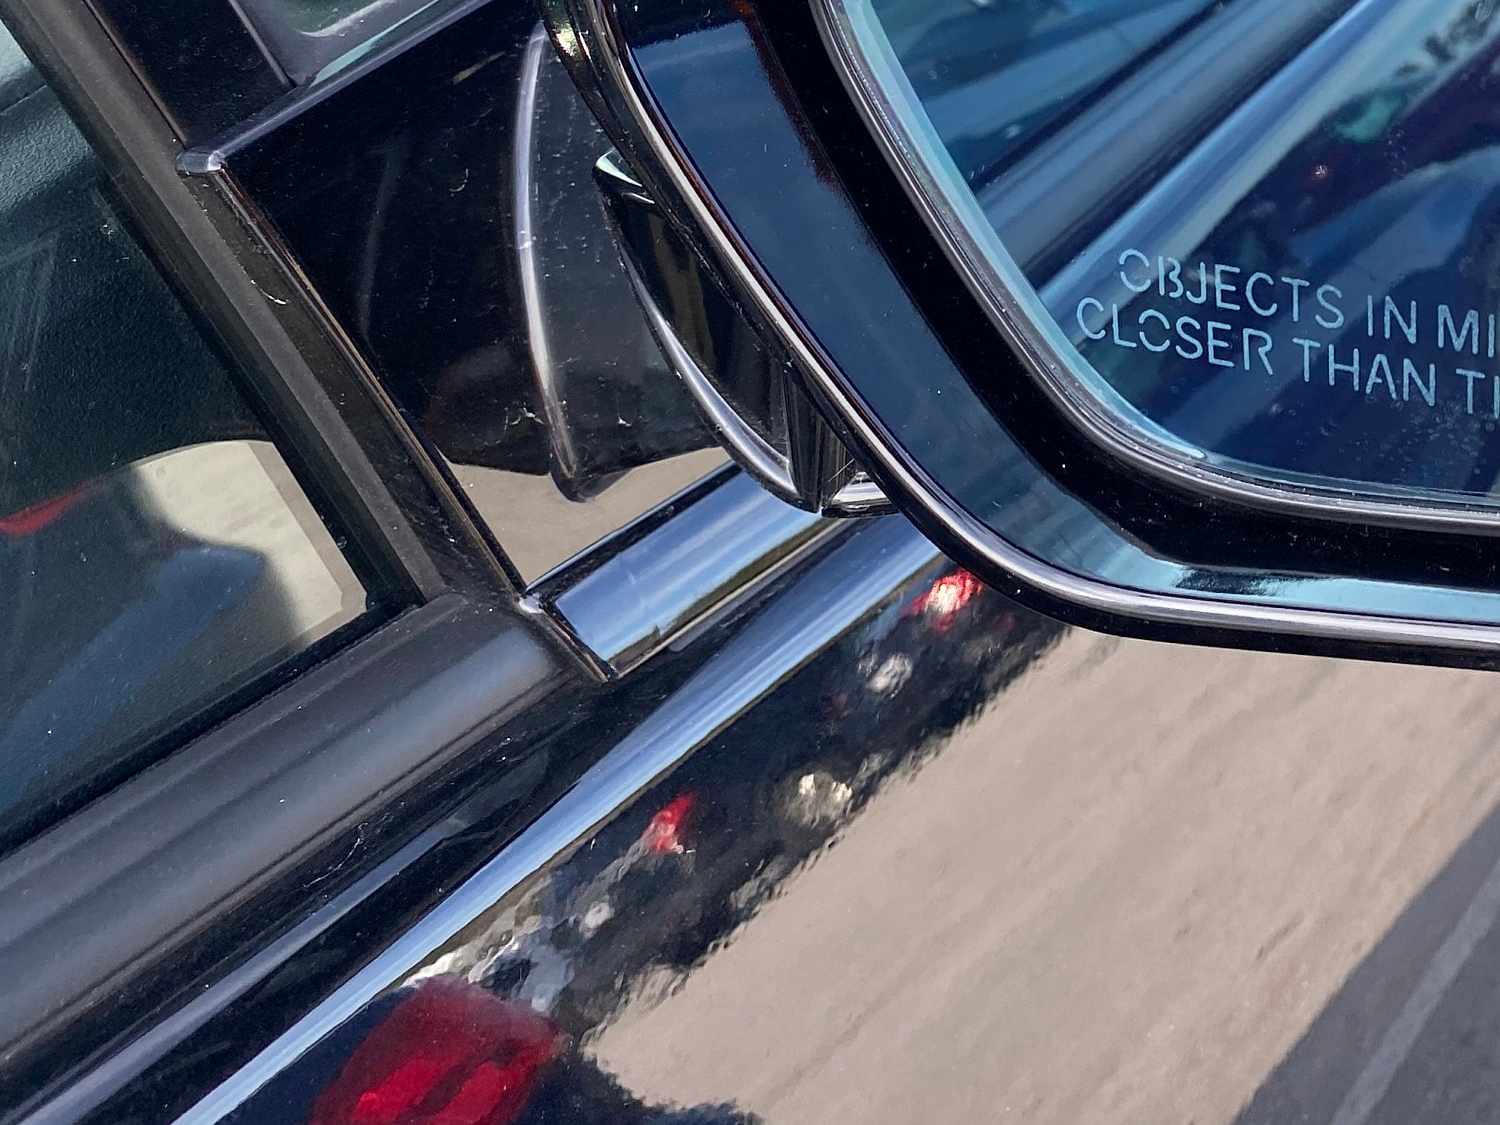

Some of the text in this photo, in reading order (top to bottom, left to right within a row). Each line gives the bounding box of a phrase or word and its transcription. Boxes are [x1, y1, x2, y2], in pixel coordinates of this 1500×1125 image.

[1118, 248, 1345, 329] OBJECTS
[1366, 295, 1418, 345] IN
[1076, 296, 1274, 376] CLOSER
[1292, 338, 1437, 409] THAN
